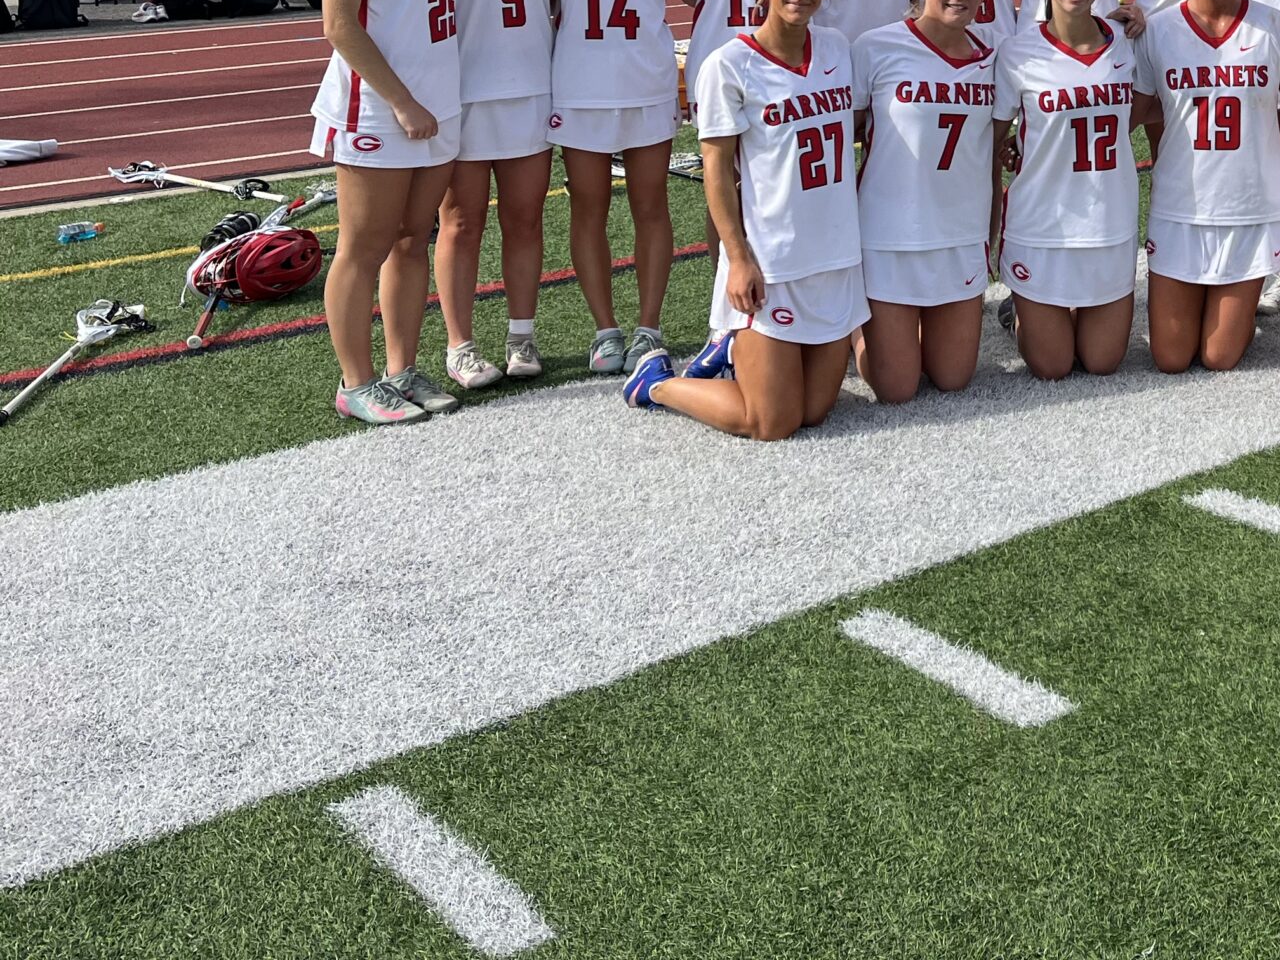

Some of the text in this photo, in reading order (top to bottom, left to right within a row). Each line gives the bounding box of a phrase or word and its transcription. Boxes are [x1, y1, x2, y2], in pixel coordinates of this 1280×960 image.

[1038, 82, 1133, 113] GARNET
[1165, 65, 1269, 90] GARNETS
[763, 85, 852, 127] GARNETS
[1192, 96, 1241, 151] 19
[796, 121, 844, 191] 27
[936, 113, 969, 170] 7
[1070, 114, 1119, 172] 12
